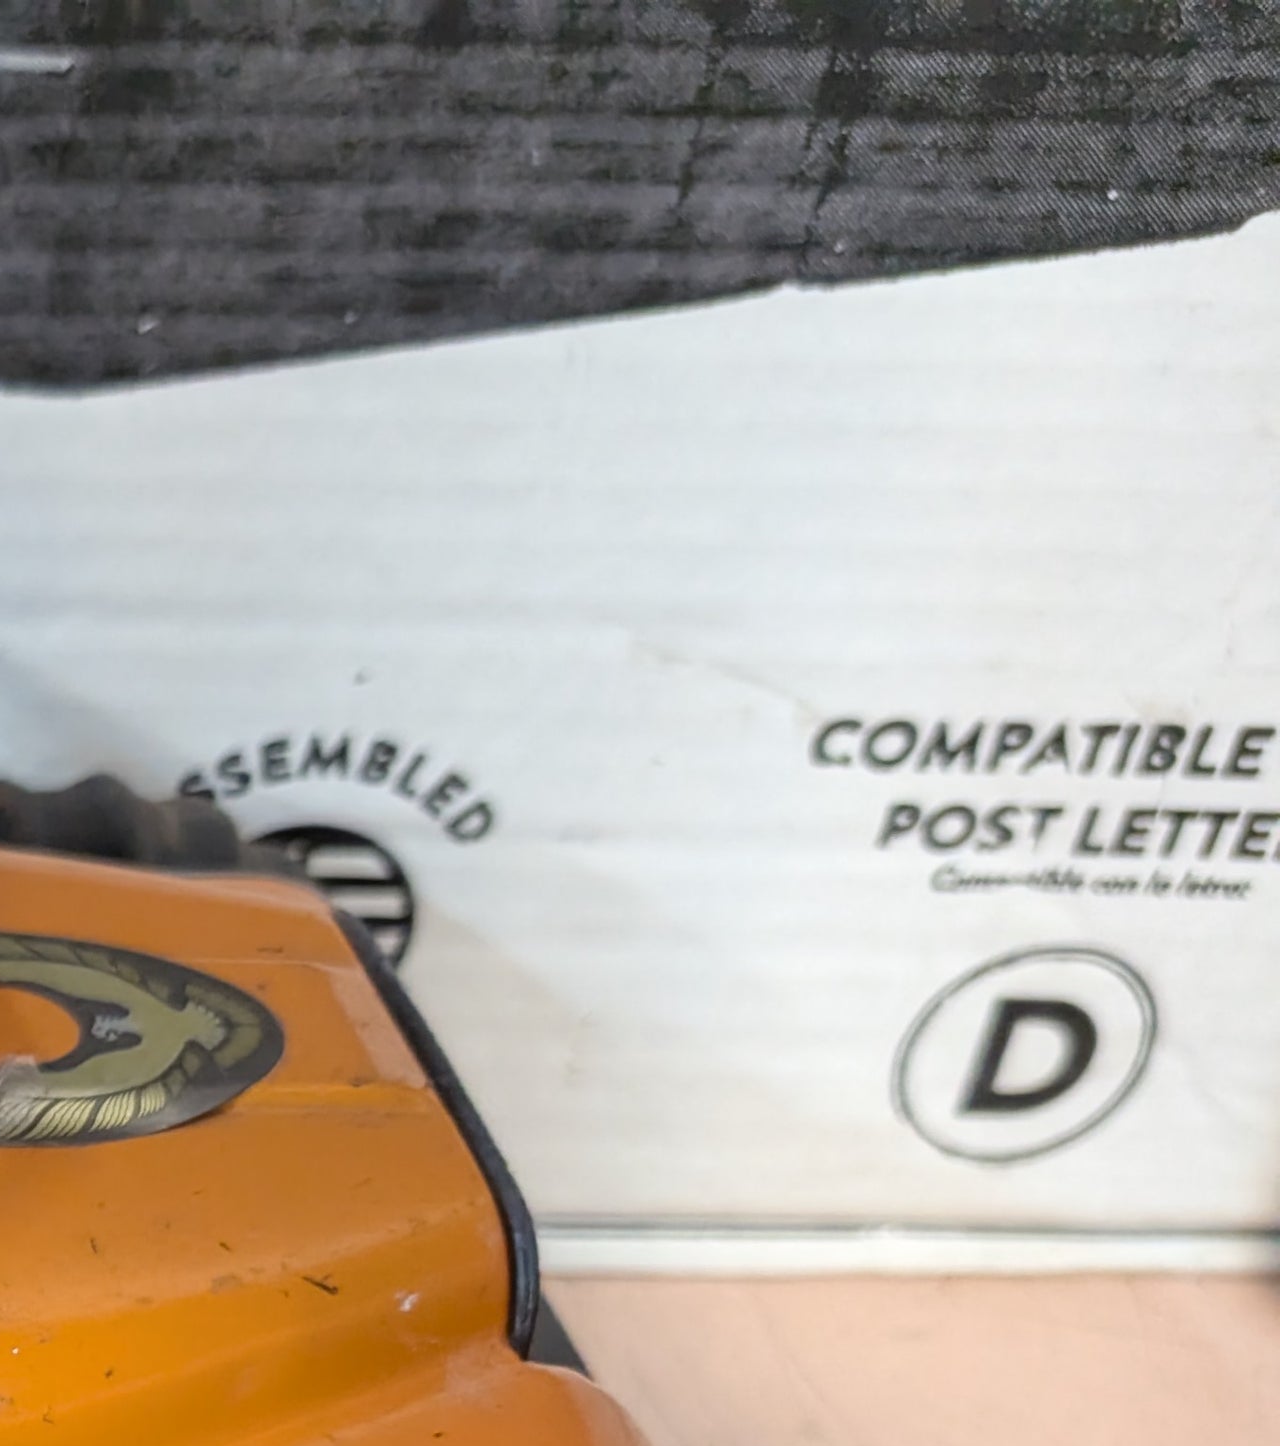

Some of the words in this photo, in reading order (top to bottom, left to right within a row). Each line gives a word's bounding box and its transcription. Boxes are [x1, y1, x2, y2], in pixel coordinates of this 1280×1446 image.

[809, 719, 1277, 778] COMPATIBLE
[874, 802, 1064, 853] POST
[1071, 805, 1280, 861] LETTE
[955, 996, 1098, 1116] D
